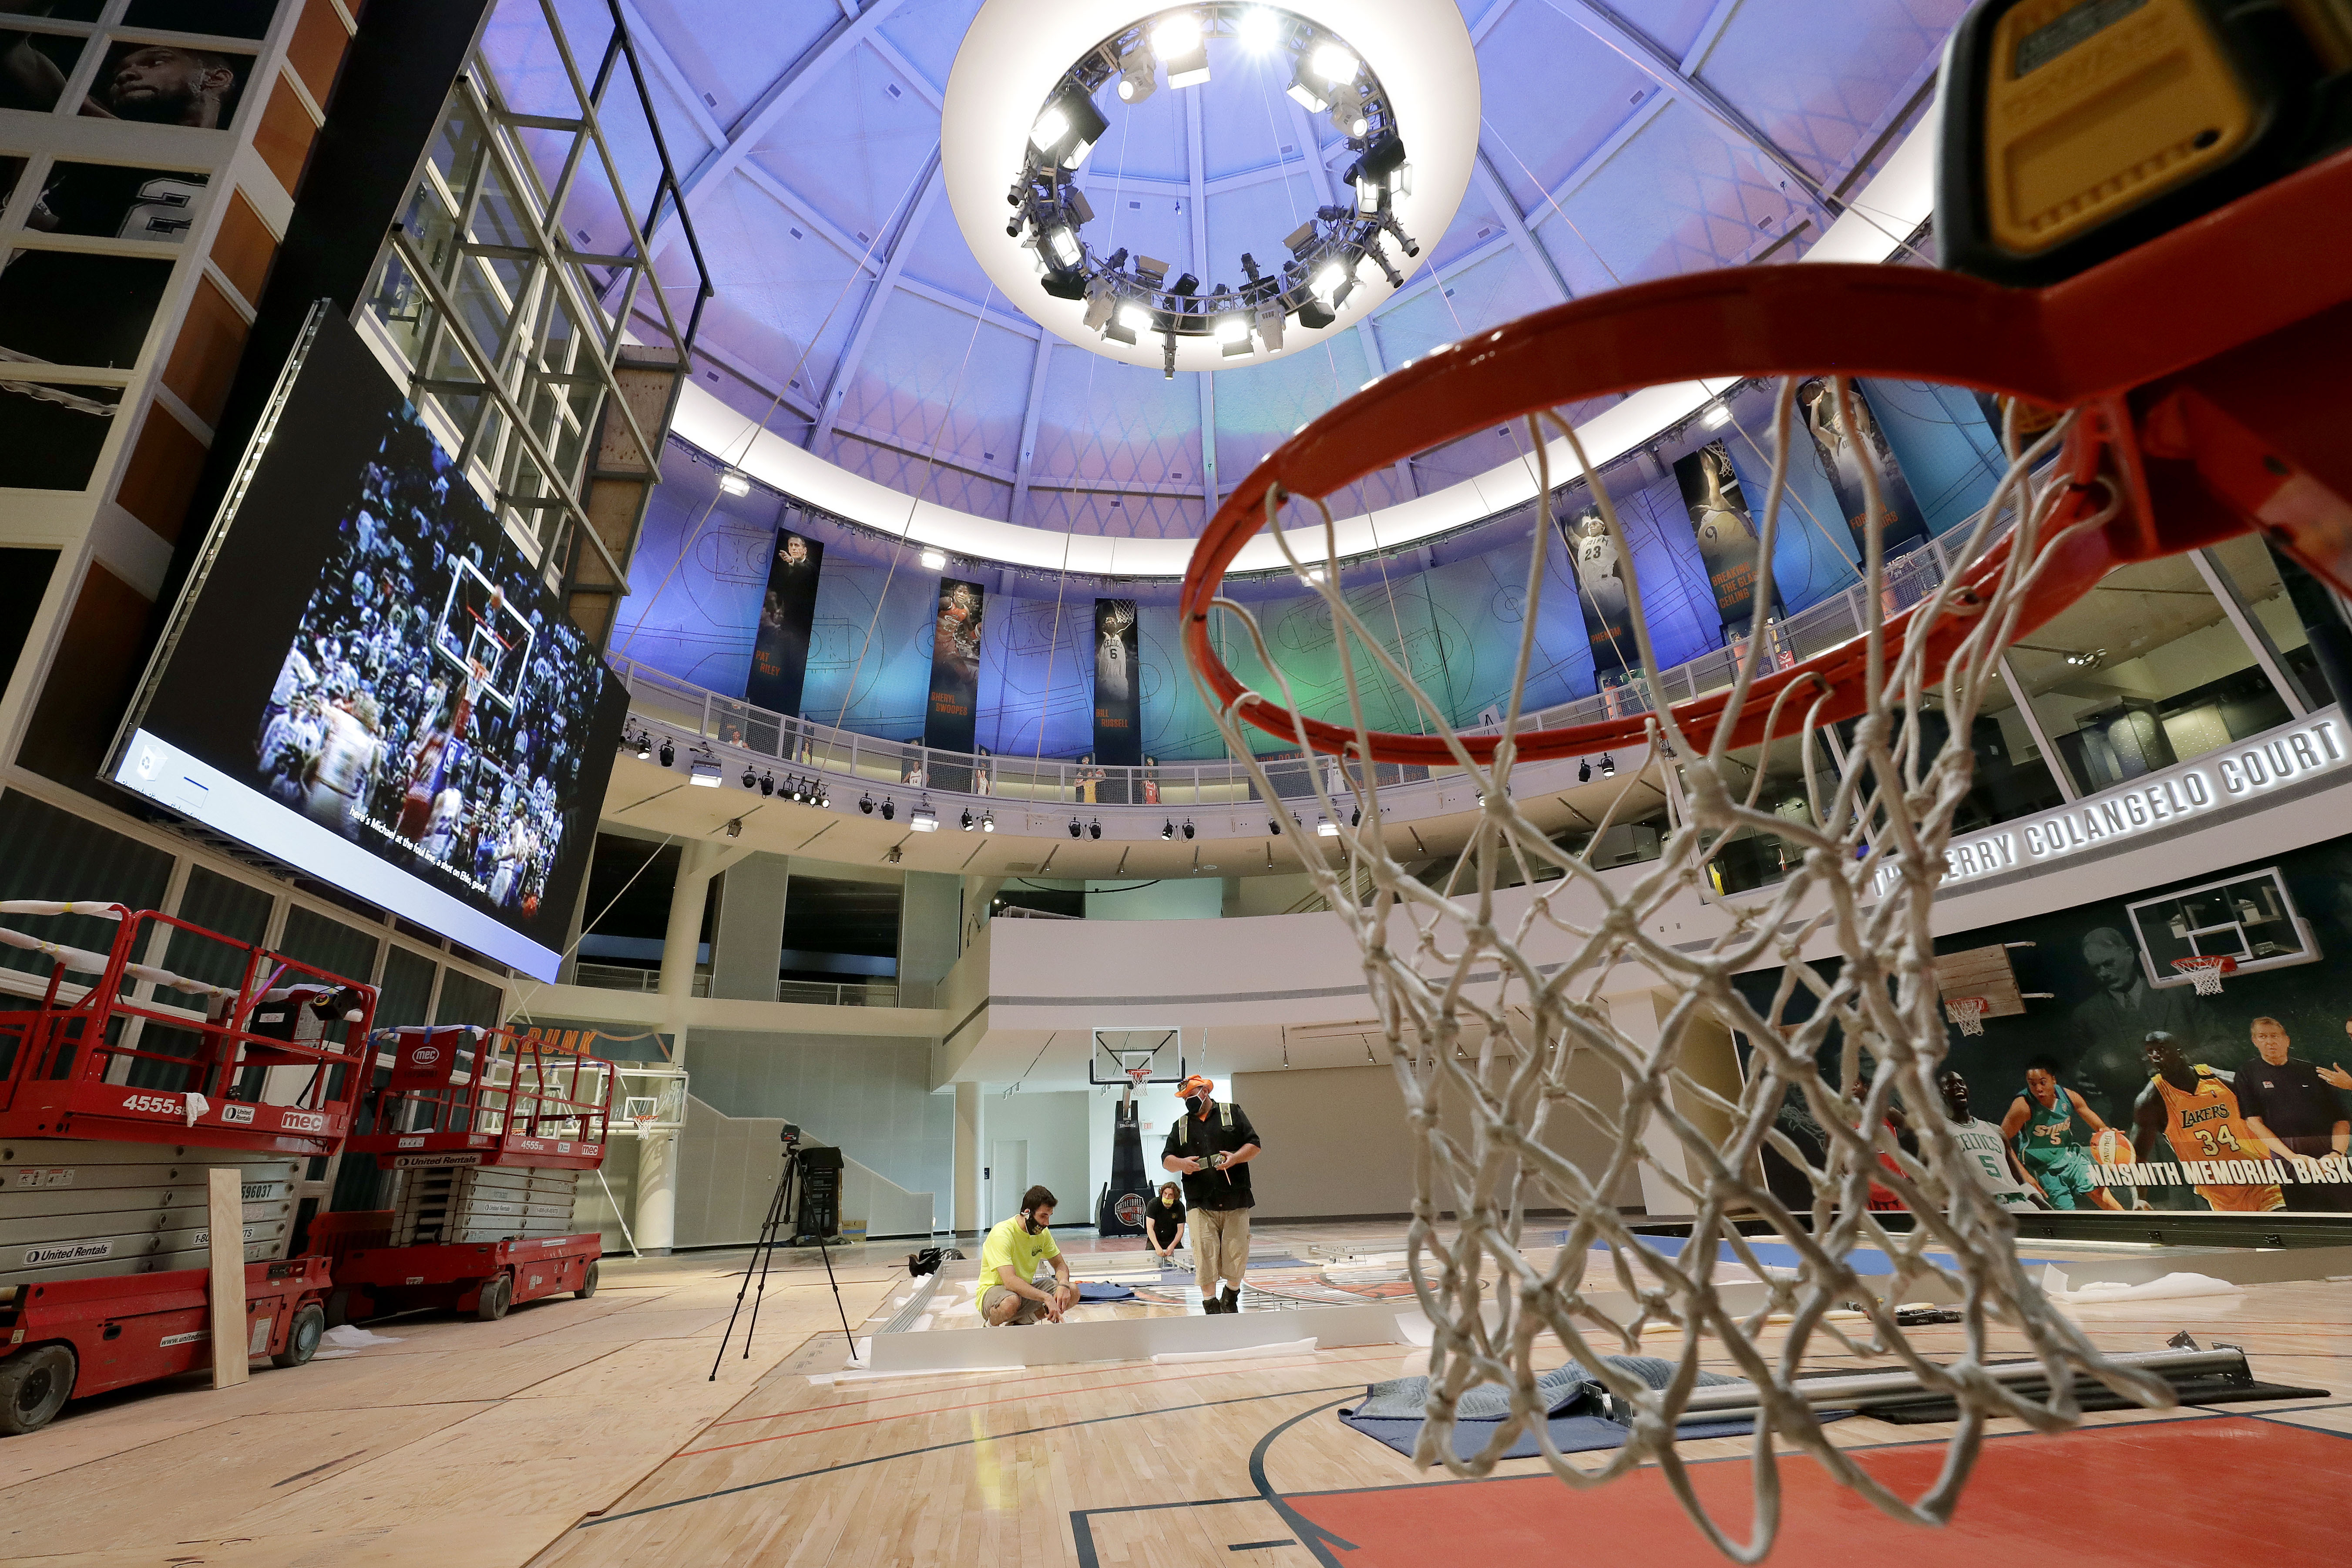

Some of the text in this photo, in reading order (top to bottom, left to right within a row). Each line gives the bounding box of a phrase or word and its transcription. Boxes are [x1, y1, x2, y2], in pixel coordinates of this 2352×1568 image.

[1705, 526, 1717, 544] 9
[1585, 546, 1601, 561] 23
[1711, 562, 1751, 587] BREAKING
[1721, 580, 1737, 594] THE
[1719, 588, 1750, 609] CEILING
[1590, 627, 1622, 644] PHENOM
[756, 650, 770, 662] PAT
[1110, 648, 1118, 659] 6
[760, 663, 780, 676] RILEY
[931, 692, 956, 704] SHERYL
[936, 703, 968, 716] SWOOPES
[1095, 708, 1109, 717] BILL
[1101, 719, 1128, 728] RUSSELL
[1943, 835, 2013, 879] ERRY
[2023, 773, 2210, 855] COLANGELO
[2218, 722, 2340, 793] COURT
[349, 805, 370, 826] here's
[370, 818, 397, 840] Michael
[395, 834, 403, 844] at
[403, 837, 413, 850] the
[413, 843, 425, 858] foul
[425, 850, 436, 866] line,
[441, 860, 454, 873] shot
[453, 867, 460, 878] on
[471, 881, 487, 893] good!
[416, 1051, 436, 1060] mec
[283, 1112, 322, 1130] mec
[2181, 1104, 2230, 1128] LAKERS
[2050, 1133, 2062, 1145] 5
[2194, 1124, 2241, 1157] 34
[582, 1145, 598, 1154] mec
[2103, 1135, 2113, 1163] SPALDING
[411, 1157, 442, 1165] United
[1978, 1155, 2002, 1179] 5
[2088, 1162, 2182, 1187] NAISMITH
[2183, 1158, 2294, 1185] MEMORIAL
[1117, 1198, 1142, 1210] BASKETBALL
[41, 1244, 108, 1261] United Rentals
